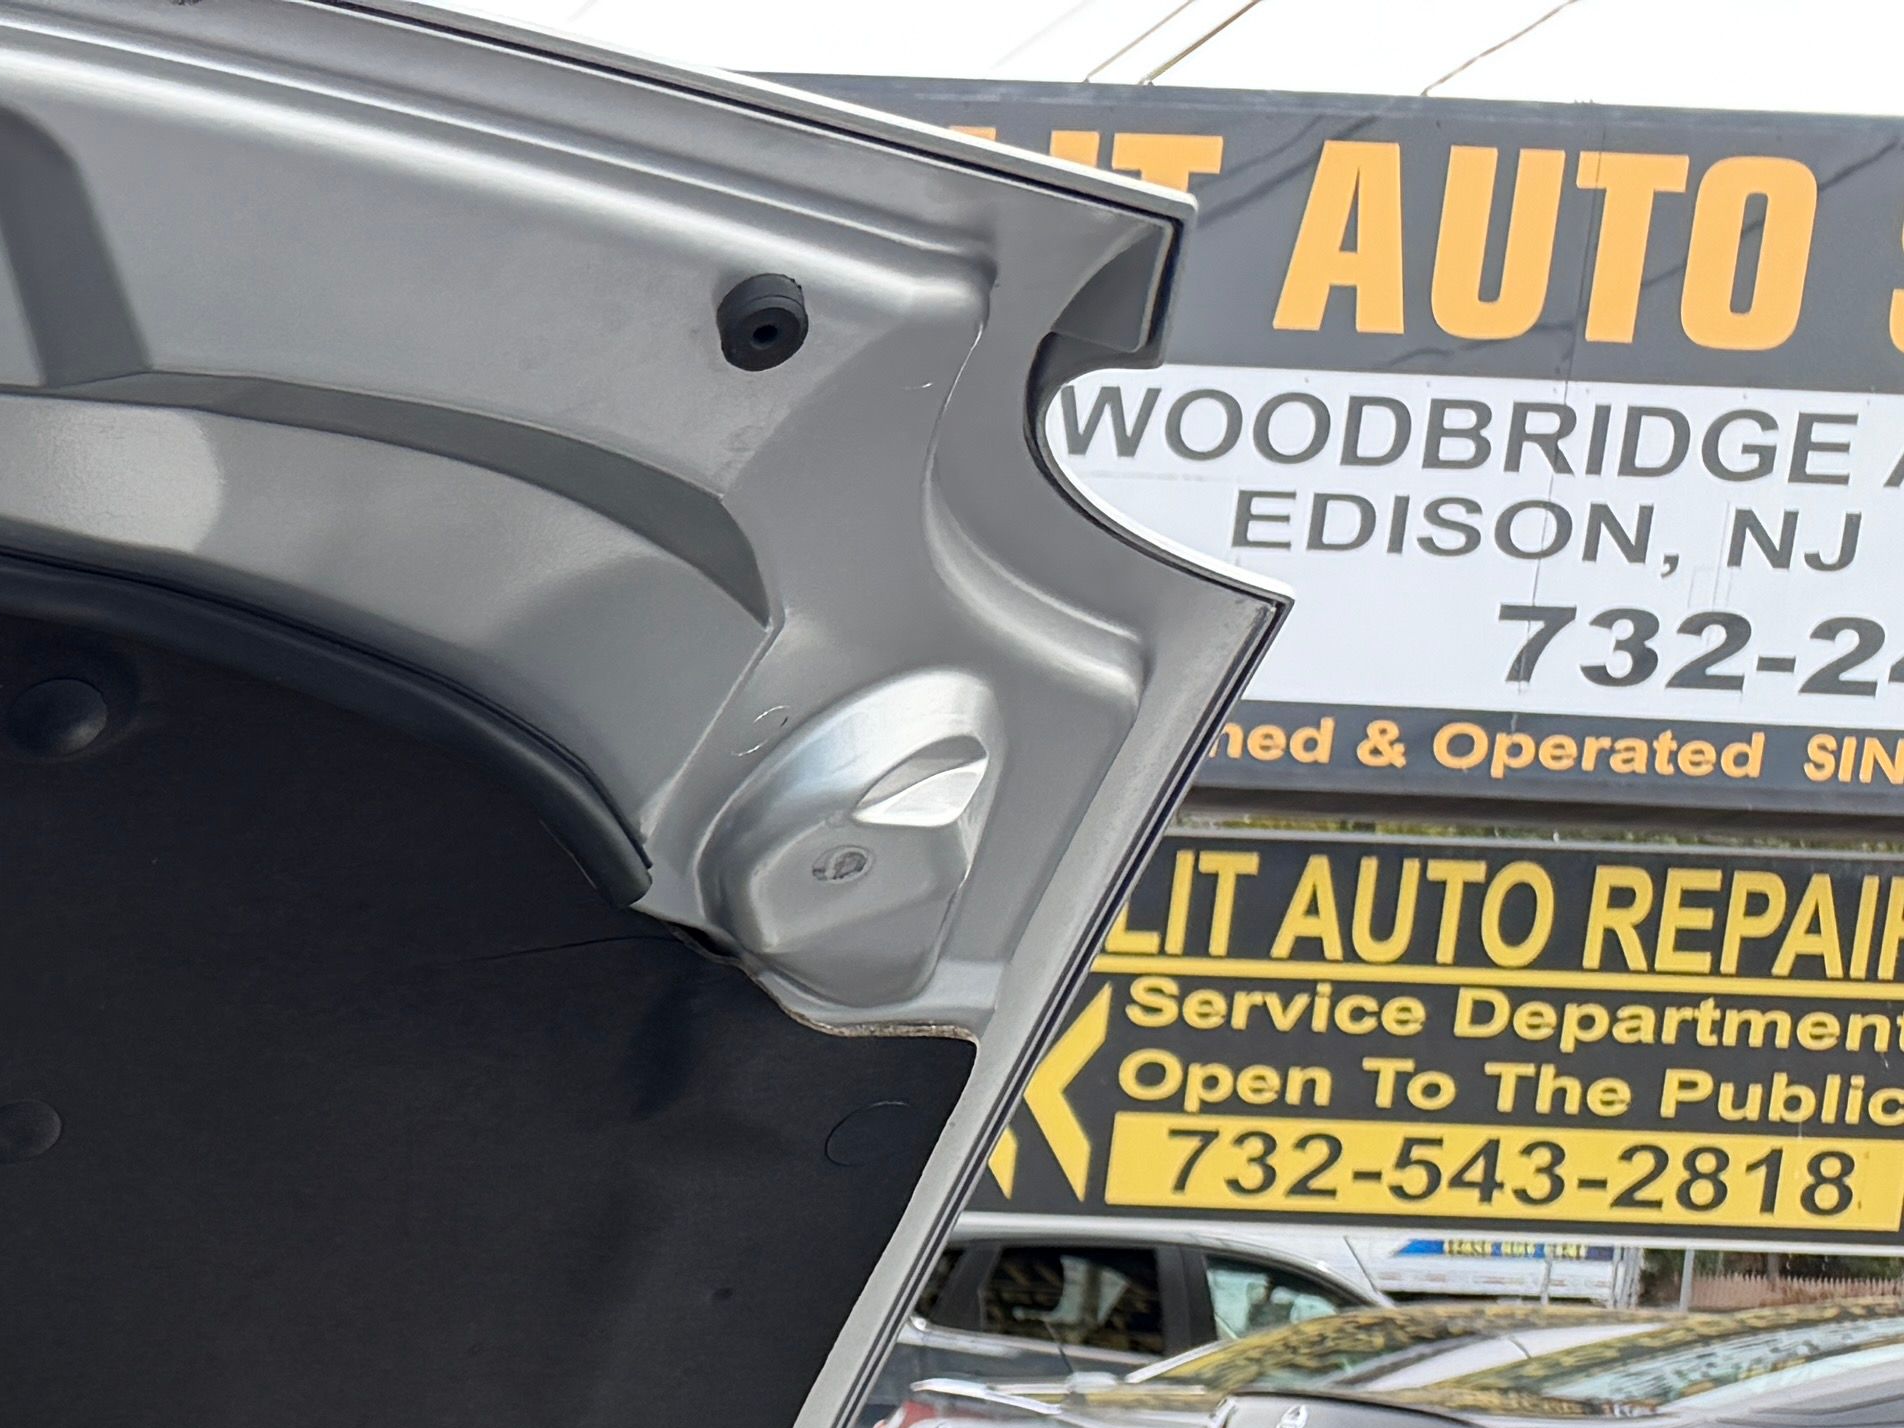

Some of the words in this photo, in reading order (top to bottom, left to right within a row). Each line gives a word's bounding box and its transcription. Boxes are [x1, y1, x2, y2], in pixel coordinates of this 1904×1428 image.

[1272, 139, 1820, 352] AUTO
[1060, 383, 1860, 484] WOODBRIDGE
[1231, 488, 1680, 578] EDISON,
[1728, 504, 1862, 573] NJ
[1497, 603, 1904, 698] 732-2
[1356, 718, 1408, 769] &
[1432, 720, 1766, 780] Operated
[1269, 853, 1556, 968] AUTO
[1125, 974, 1427, 1036] Service
[1117, 1046, 1332, 1113] Open
[1361, 1055, 1457, 1111] To
[1483, 1060, 1632, 1118] The
[1659, 1067, 1904, 1128] Public
[1163, 1126, 1856, 1217] 732-543-2818
